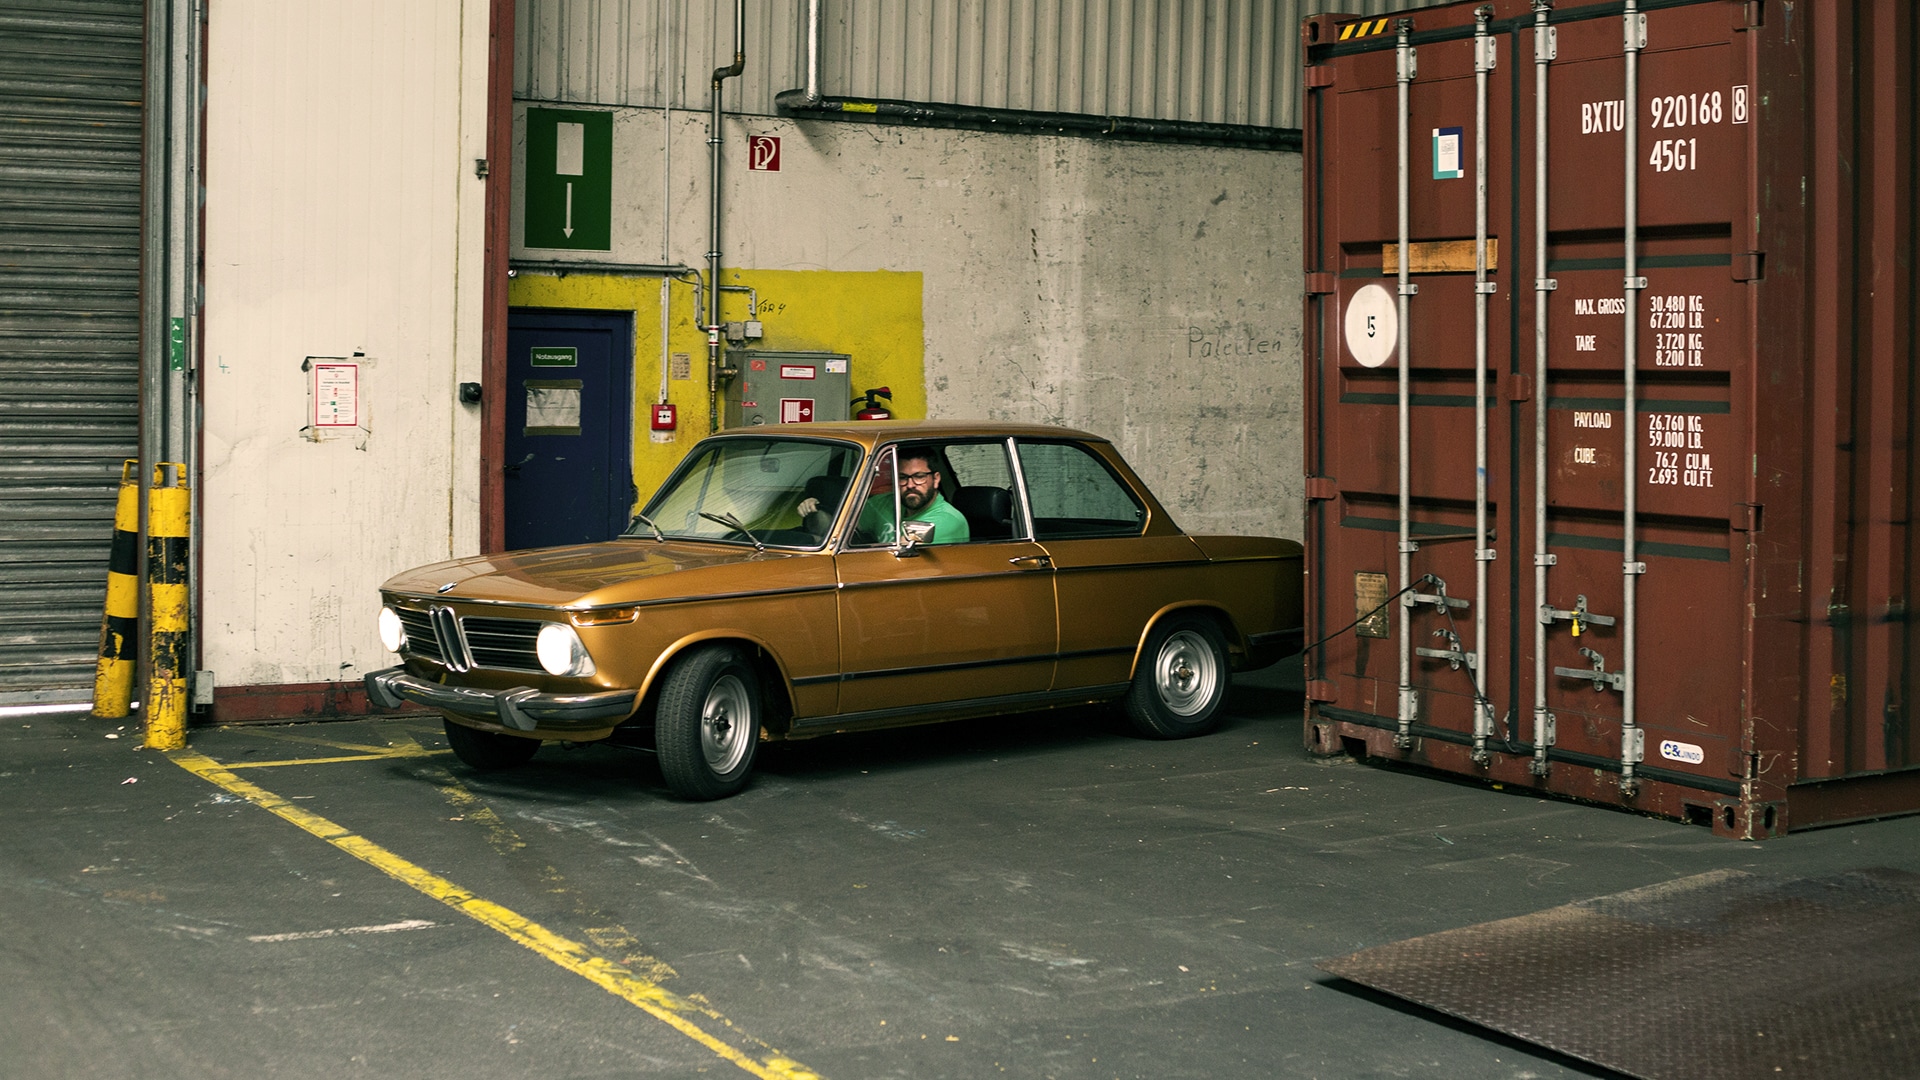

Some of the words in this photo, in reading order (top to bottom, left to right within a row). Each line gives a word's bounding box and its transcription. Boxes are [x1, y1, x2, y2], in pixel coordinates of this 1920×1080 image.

[1582, 100, 1624, 134] BXTU
[1651, 91, 1722, 128] 920168
[1734, 88, 1746, 121] 8
[1649, 138, 1696, 172] 45G1
[1575, 299, 1597, 315] MAX.
[1597, 298, 1625, 315] GROSS
[1688, 295, 1705, 312] KG.
[1367, 316, 1376, 338] 5
[1688, 312, 1704, 329] LB.
[1575, 335, 1597, 351] TARE
[1688, 333, 1704, 350] KG.
[535, 353, 573, 361] Notausgang
[1688, 350, 1704, 367] LB.
[1574, 412, 1612, 429] PAYLOAD
[1687, 415, 1704, 433] KG.
[1688, 432, 1704, 449] LB.
[1574, 447, 1597, 464] CUBE
[1655, 451, 1678, 468] 76.2
